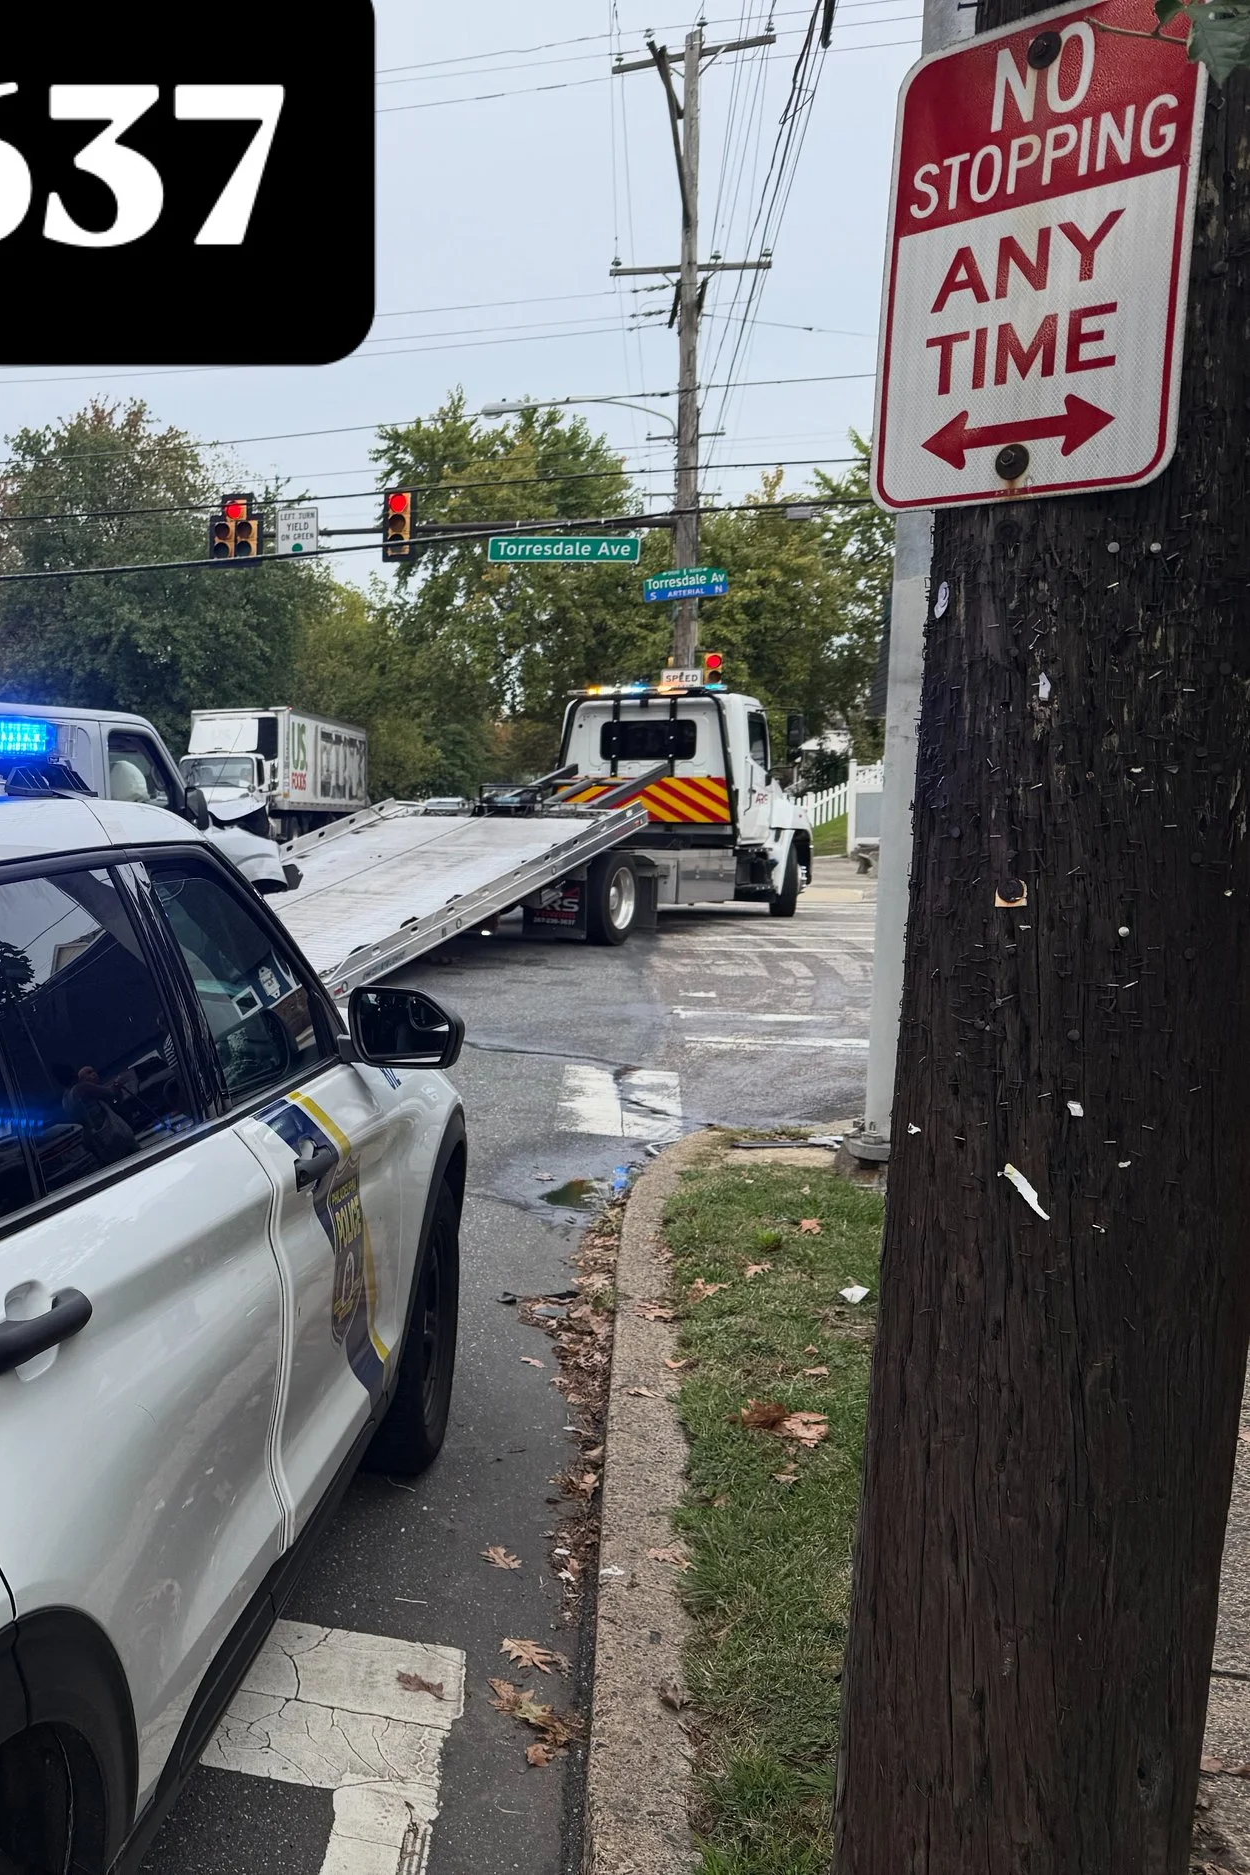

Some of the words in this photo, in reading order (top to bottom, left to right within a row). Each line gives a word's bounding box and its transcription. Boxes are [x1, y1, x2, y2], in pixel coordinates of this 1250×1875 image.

[991, 21, 1095, 133] NO
[910, 94, 1178, 219] STOPPING
[931, 208, 1126, 314] ANY
[926, 302, 1117, 396] TIME
[280, 513, 295, 521] LEFT
[299, 511, 315, 520] TURN
[287, 522, 309, 532] YIELD
[293, 533, 314, 541] GREEN
[498, 541, 591, 556] Torresdale
[598, 541, 632, 556] Ave
[646, 574, 706, 590] Torresdale
[711, 572, 725, 583] Av
[650, 592, 657, 600] S
[667, 588, 705, 598] ARTERIAL
[715, 585, 723, 593] N
[666, 674, 698, 682] SPEED
[292, 771, 307, 791] FOODS
[335, 1195, 362, 1252] POLICE
